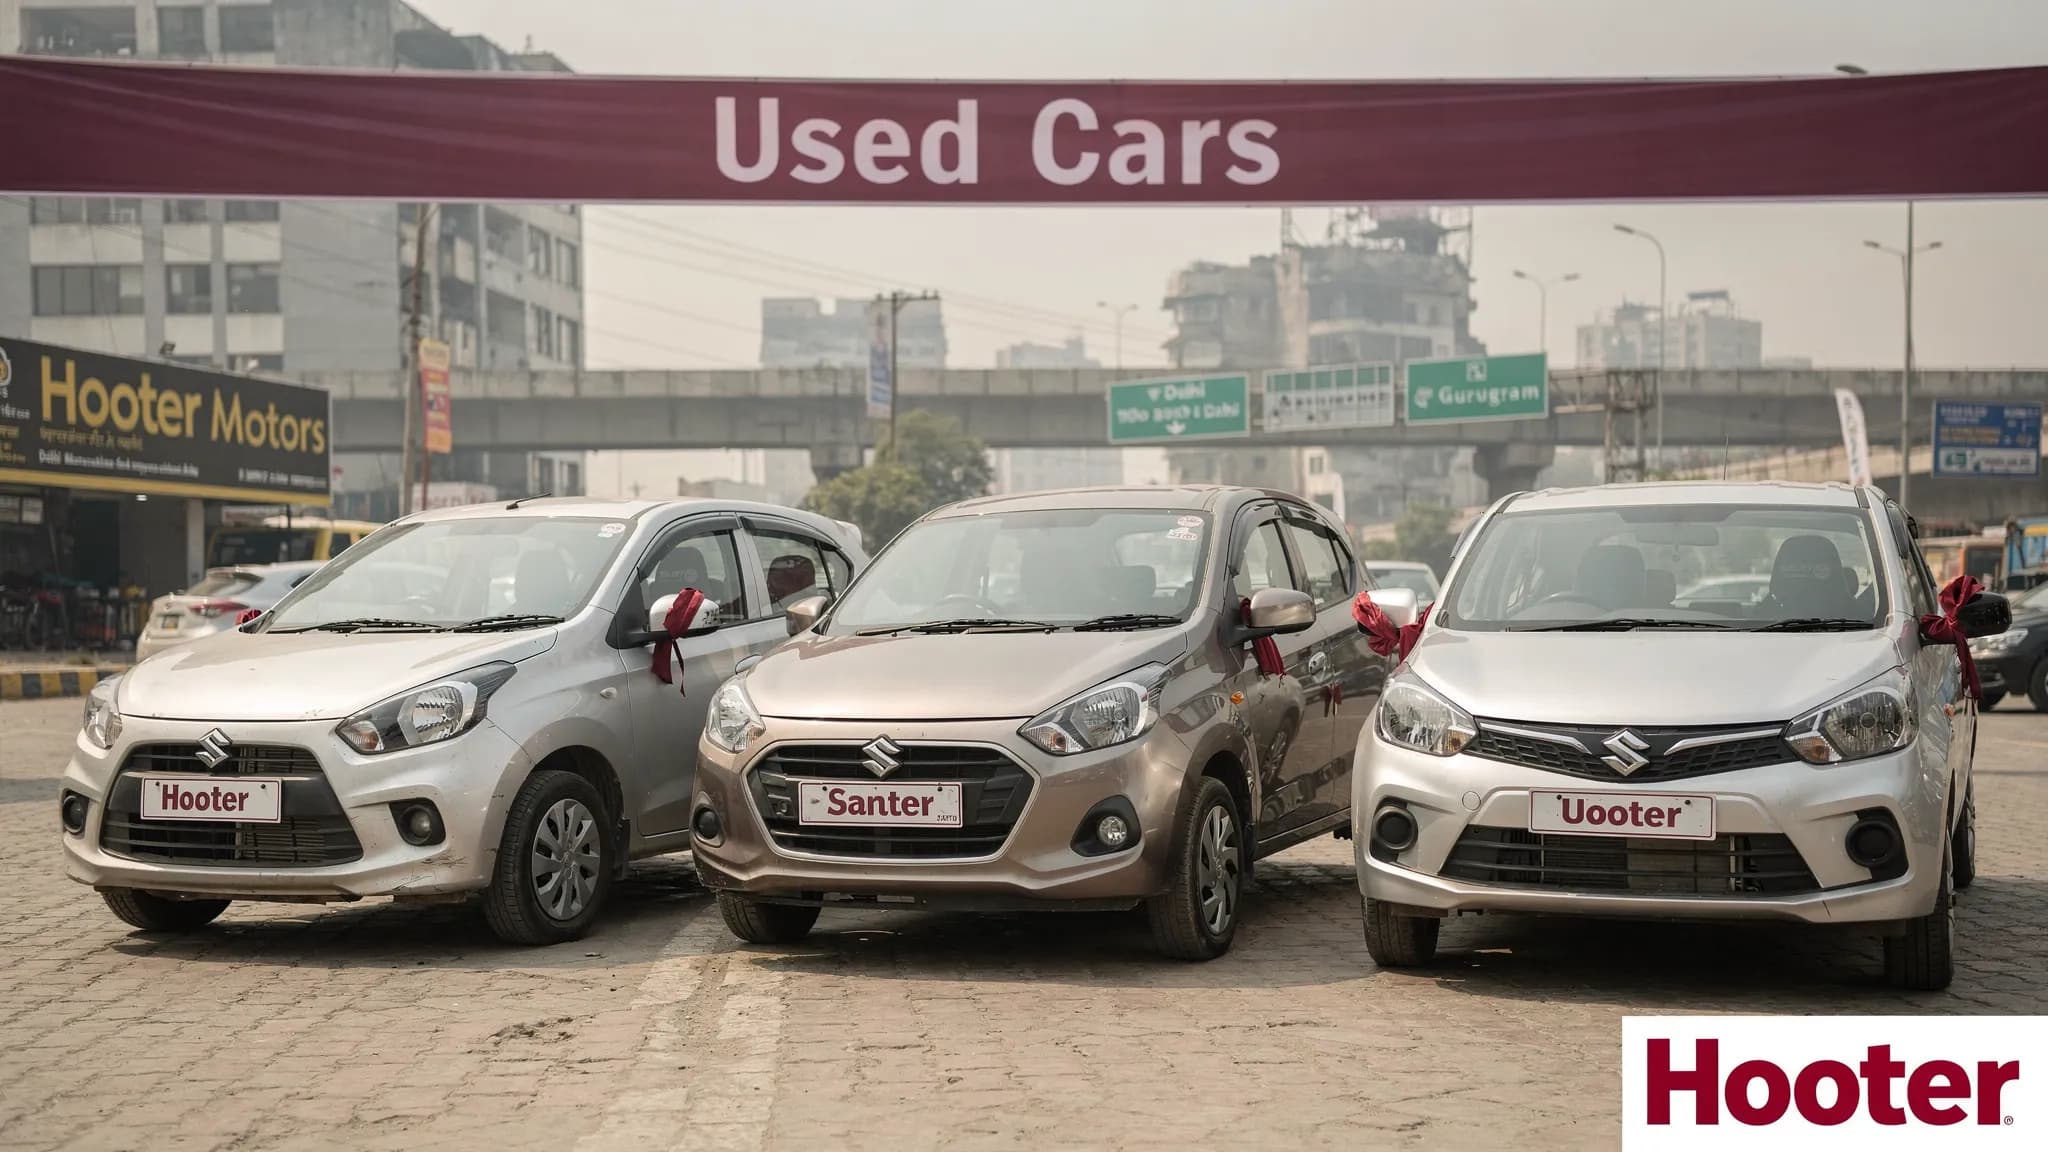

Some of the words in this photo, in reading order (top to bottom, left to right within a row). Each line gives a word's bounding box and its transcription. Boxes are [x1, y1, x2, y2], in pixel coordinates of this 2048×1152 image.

[715, 97, 979, 185] Used
[1031, 98, 1281, 186] Cars
[40, 354, 202, 438] Hooter
[210, 387, 326, 455] Motors
[1438, 384, 1540, 408] Gurugram
[161, 783, 250, 812] Hooter
[827, 787, 935, 817] Santer
[1561, 798, 1682, 828] Uooter
